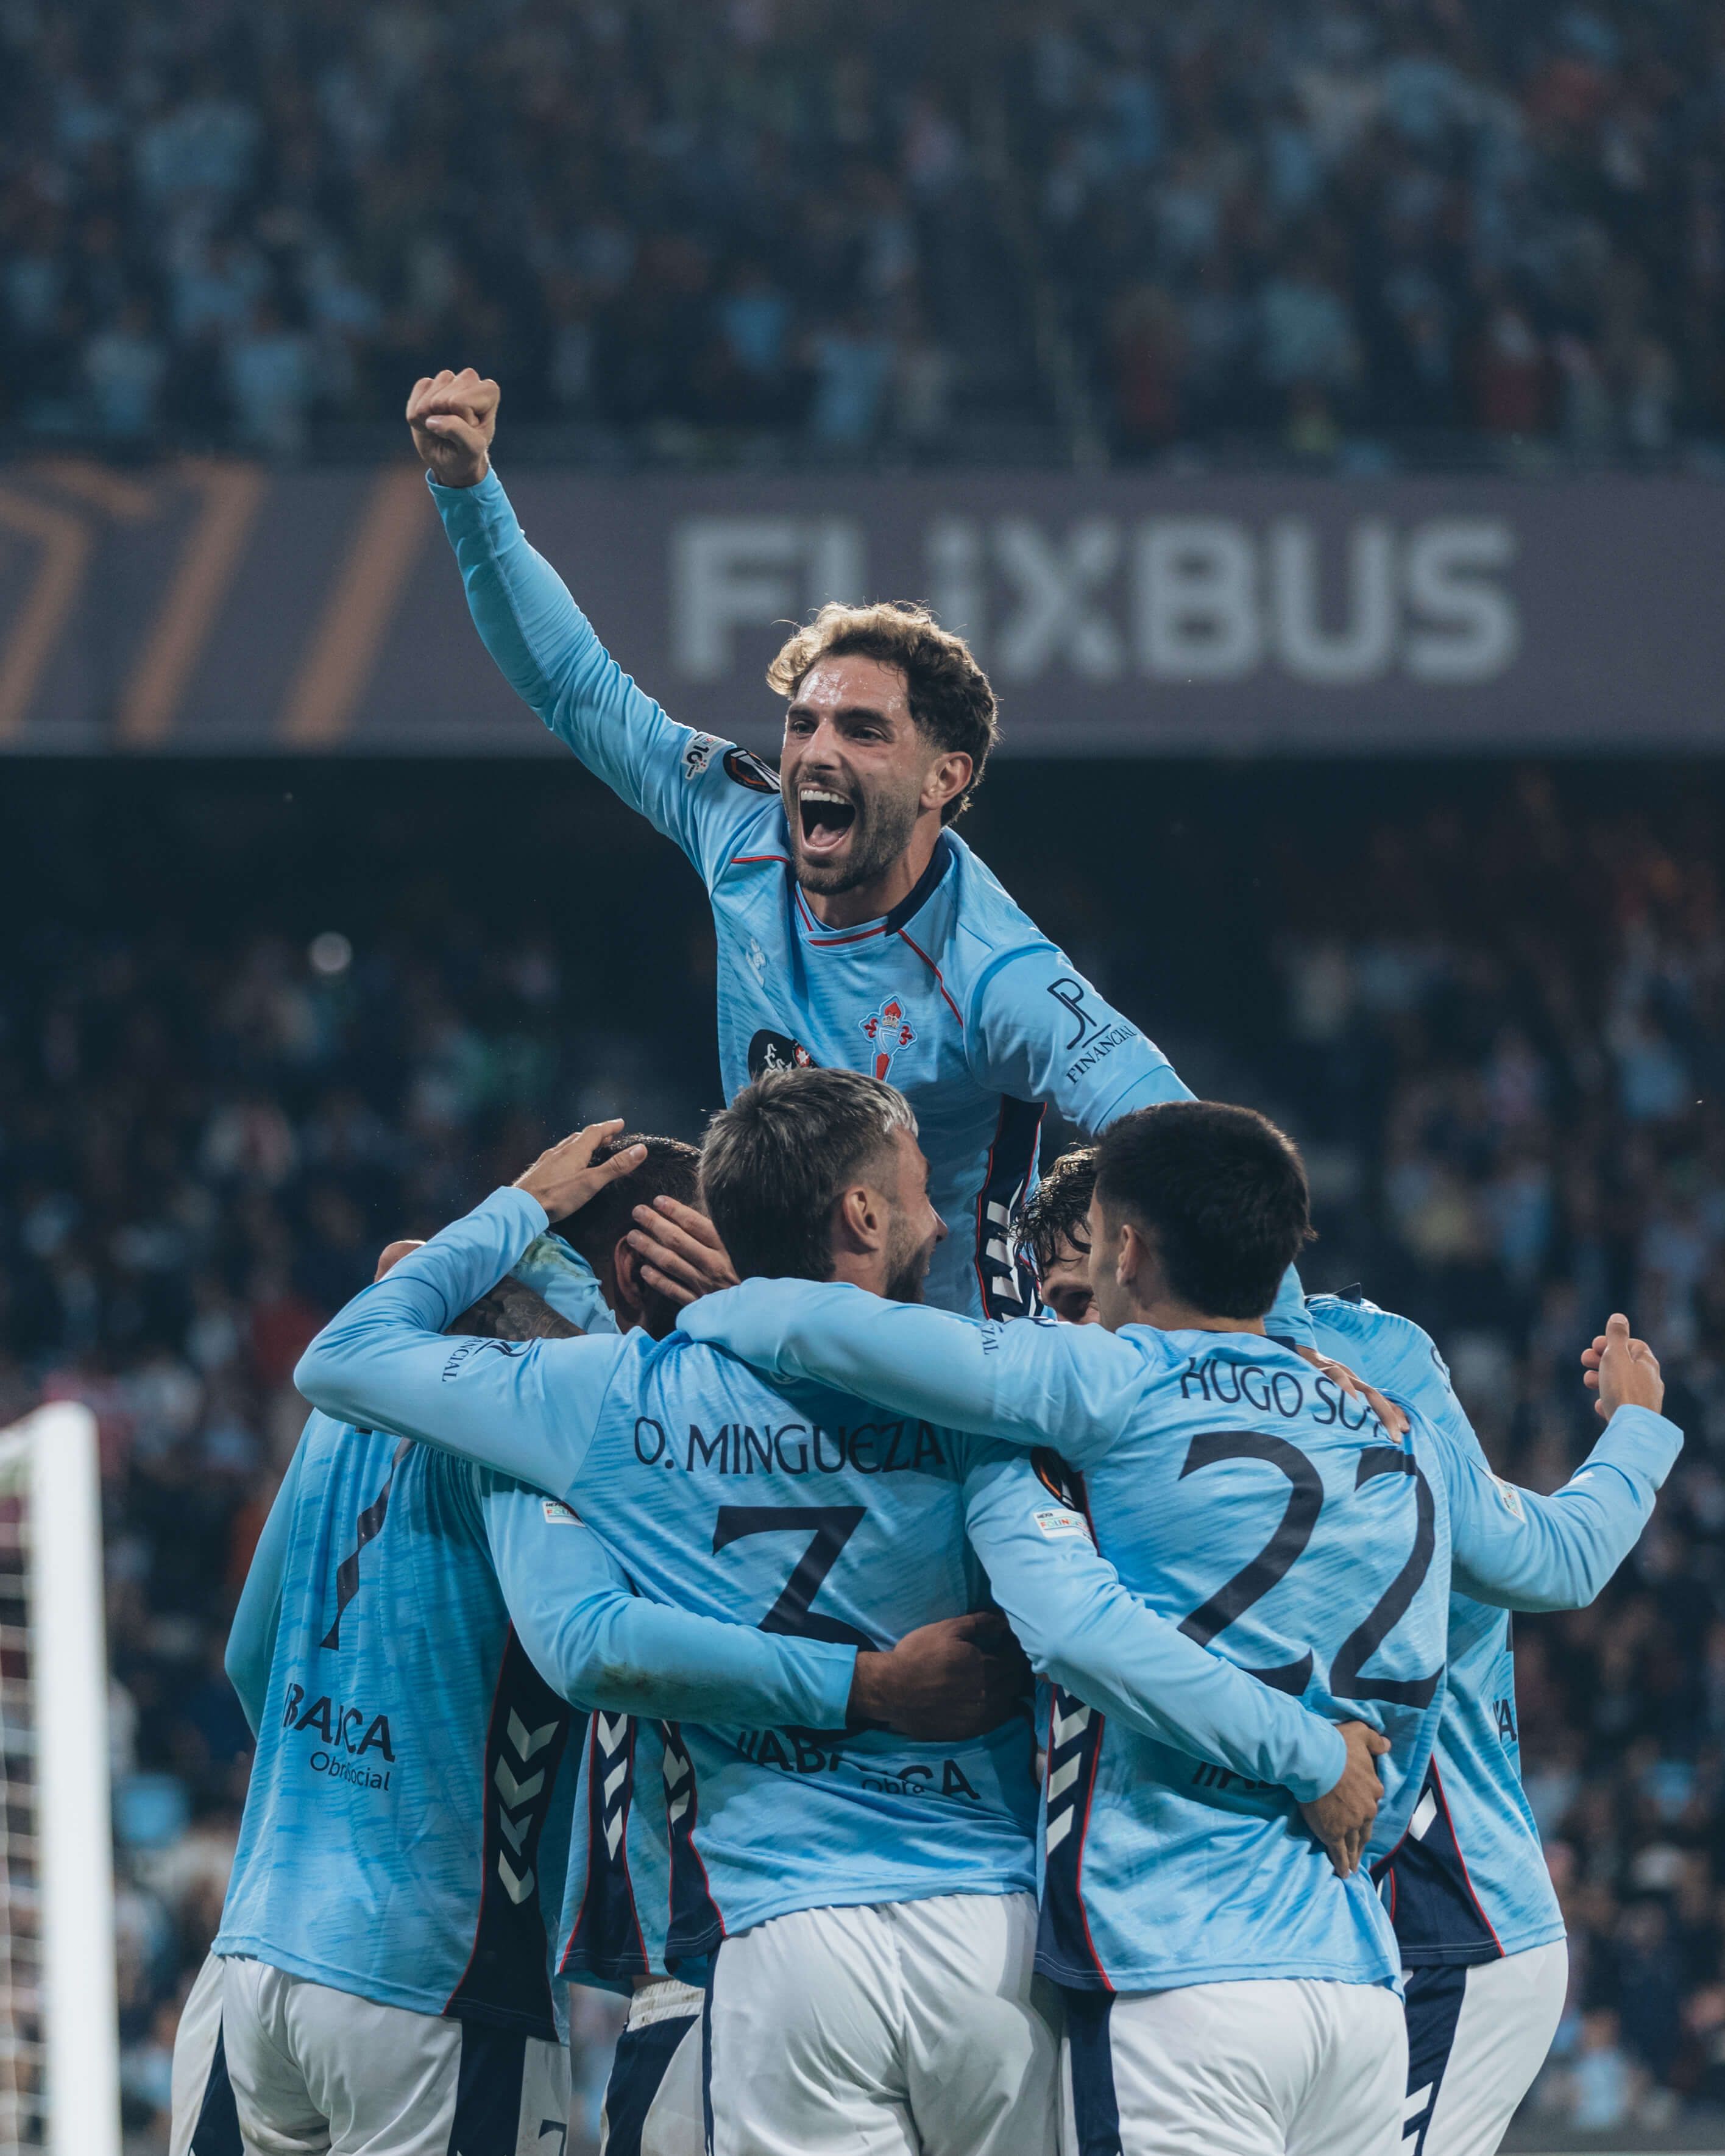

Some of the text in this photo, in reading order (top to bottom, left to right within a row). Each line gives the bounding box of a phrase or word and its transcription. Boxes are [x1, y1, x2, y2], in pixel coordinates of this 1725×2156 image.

[1180, 1357, 1303, 1418] HUGO
[634, 1416, 946, 1475] O. MINGUEZA
[1177, 1430, 1445, 1709] 22
